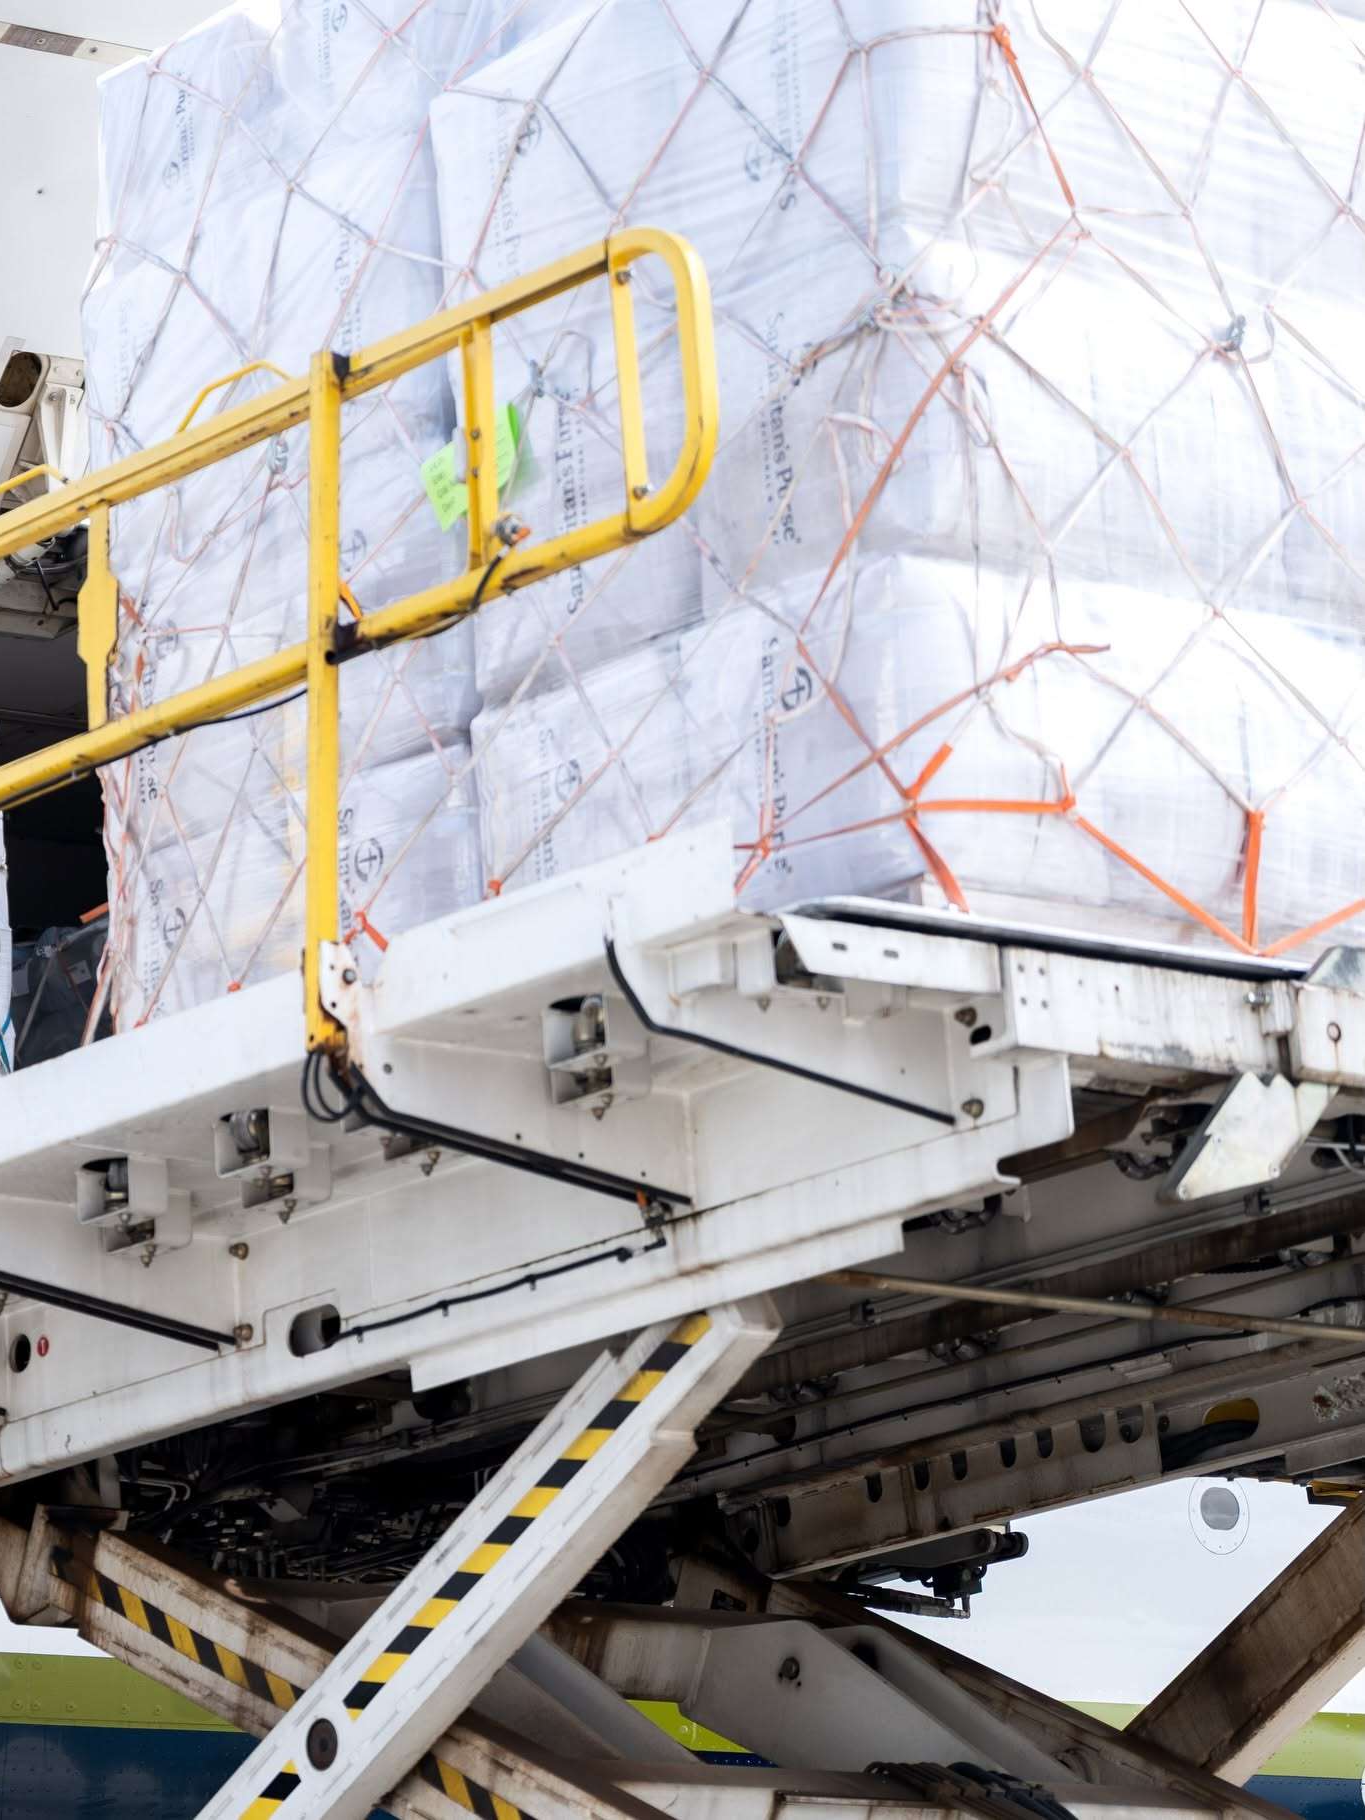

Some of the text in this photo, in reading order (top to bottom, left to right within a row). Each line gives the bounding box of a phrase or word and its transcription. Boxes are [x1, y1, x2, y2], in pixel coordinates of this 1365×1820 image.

[765, 312, 789, 464] Samaitan's
[559, 463, 585, 615] Samitan's
[538, 727, 556, 878] Saaran's
[762, 637, 786, 870] Samaan's Pure
[337, 807, 353, 930] Samarta
